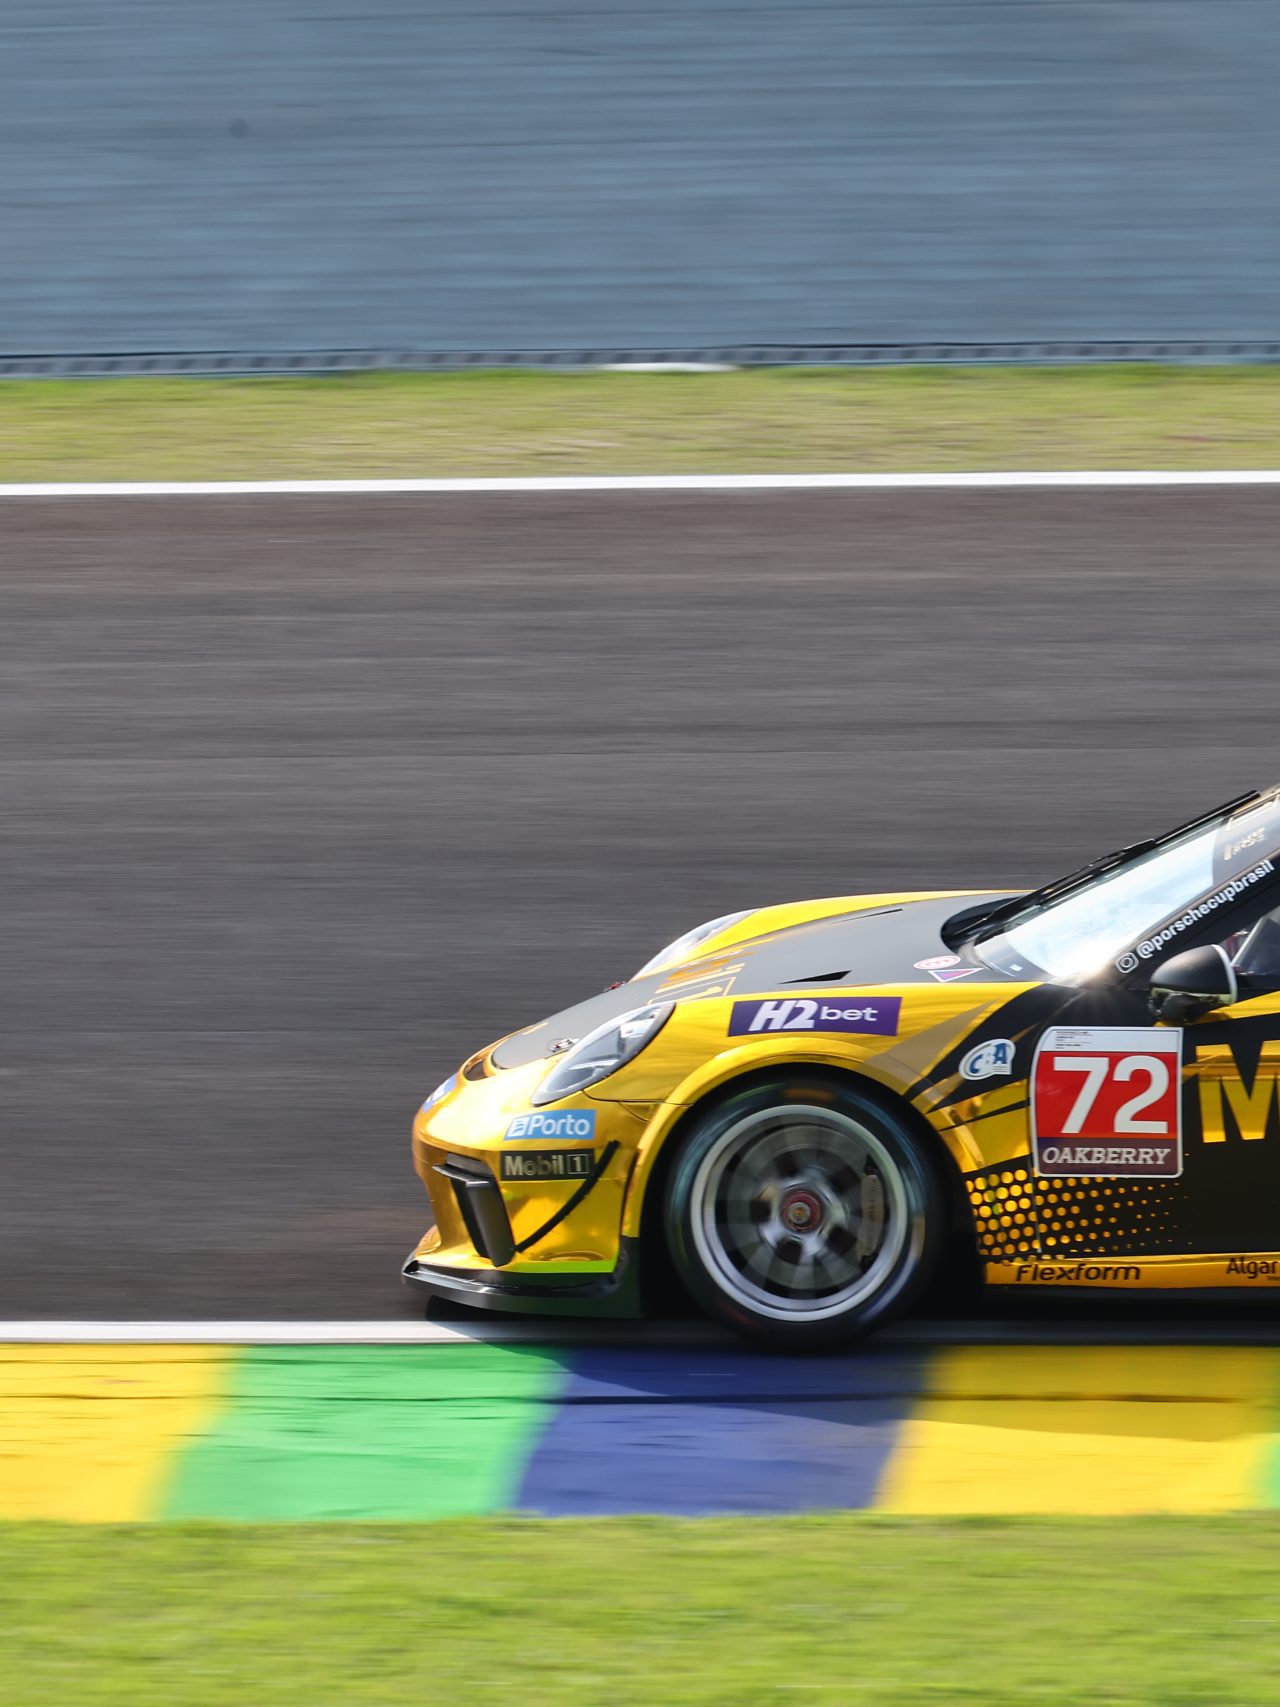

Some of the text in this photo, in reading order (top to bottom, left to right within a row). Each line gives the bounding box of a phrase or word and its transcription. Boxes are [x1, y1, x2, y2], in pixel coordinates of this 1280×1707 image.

[1136, 859, 1275, 959] @porschecupbrasil
[1053, 1055, 1170, 1134] 72
[527, 1114, 591, 1136] Porto
[504, 1154, 564, 1176] Mobil
[1042, 1145, 1171, 1165] OAKBERRY
[1015, 1263, 1141, 1282] Flexform
[1226, 1256, 1279, 1279] Algar
